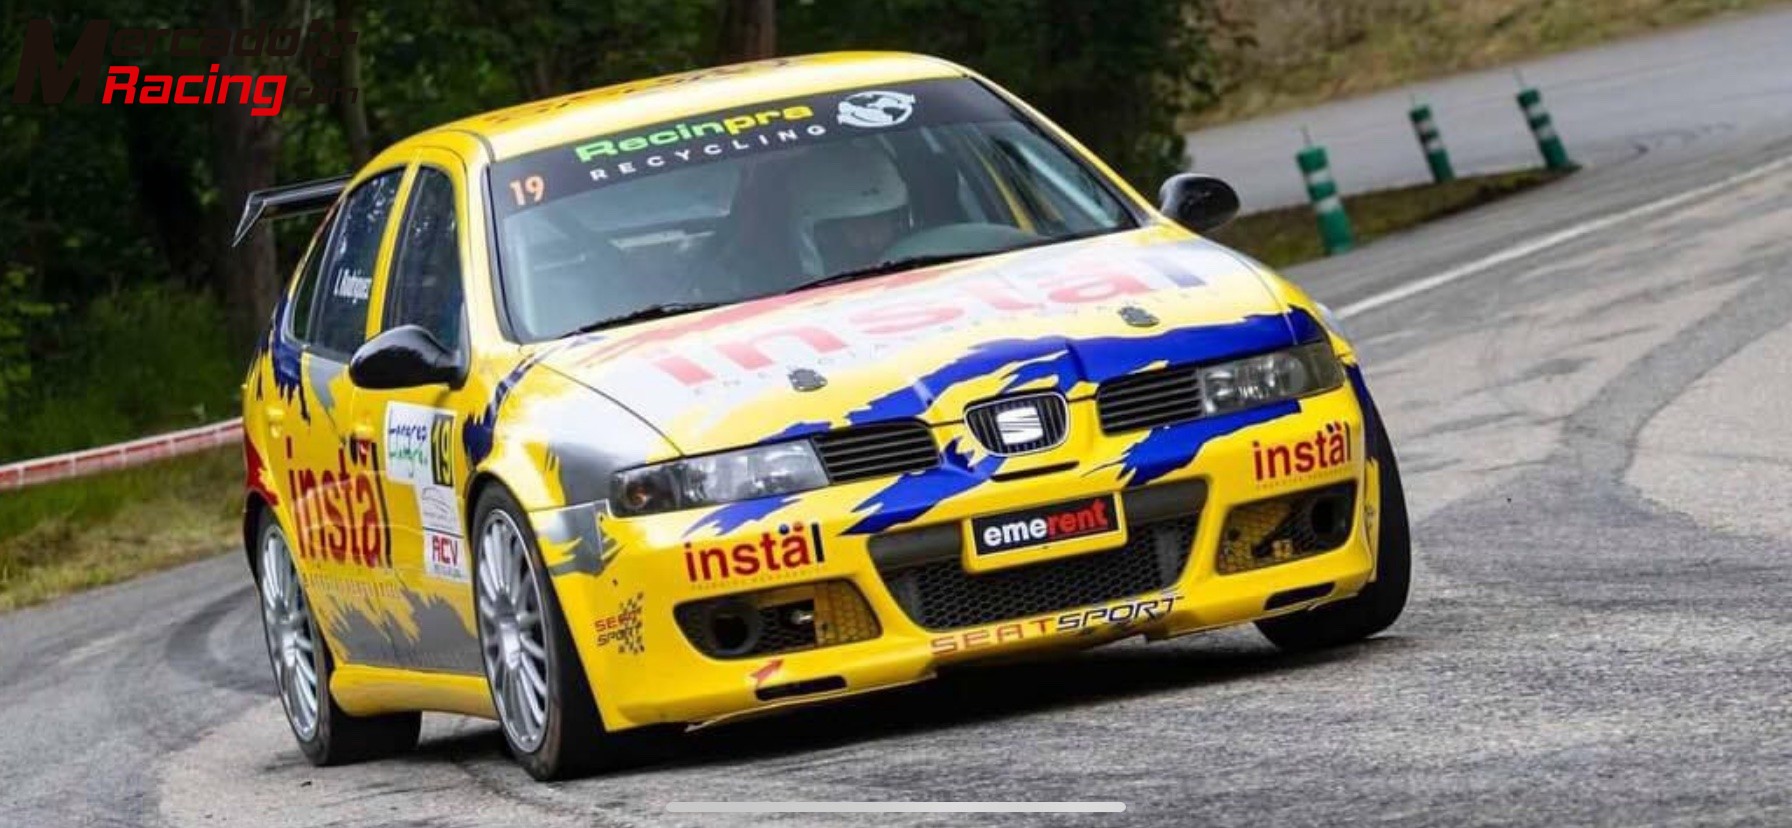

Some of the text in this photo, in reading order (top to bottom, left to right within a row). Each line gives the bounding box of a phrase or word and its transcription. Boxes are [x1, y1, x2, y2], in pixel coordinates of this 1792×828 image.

[575, 103, 814, 164] Recinpra
[589, 125, 826, 182] RECYCLING
[511, 175, 545, 206] 19
[432, 418, 452, 484] 19
[983, 499, 1108, 547] emerent
